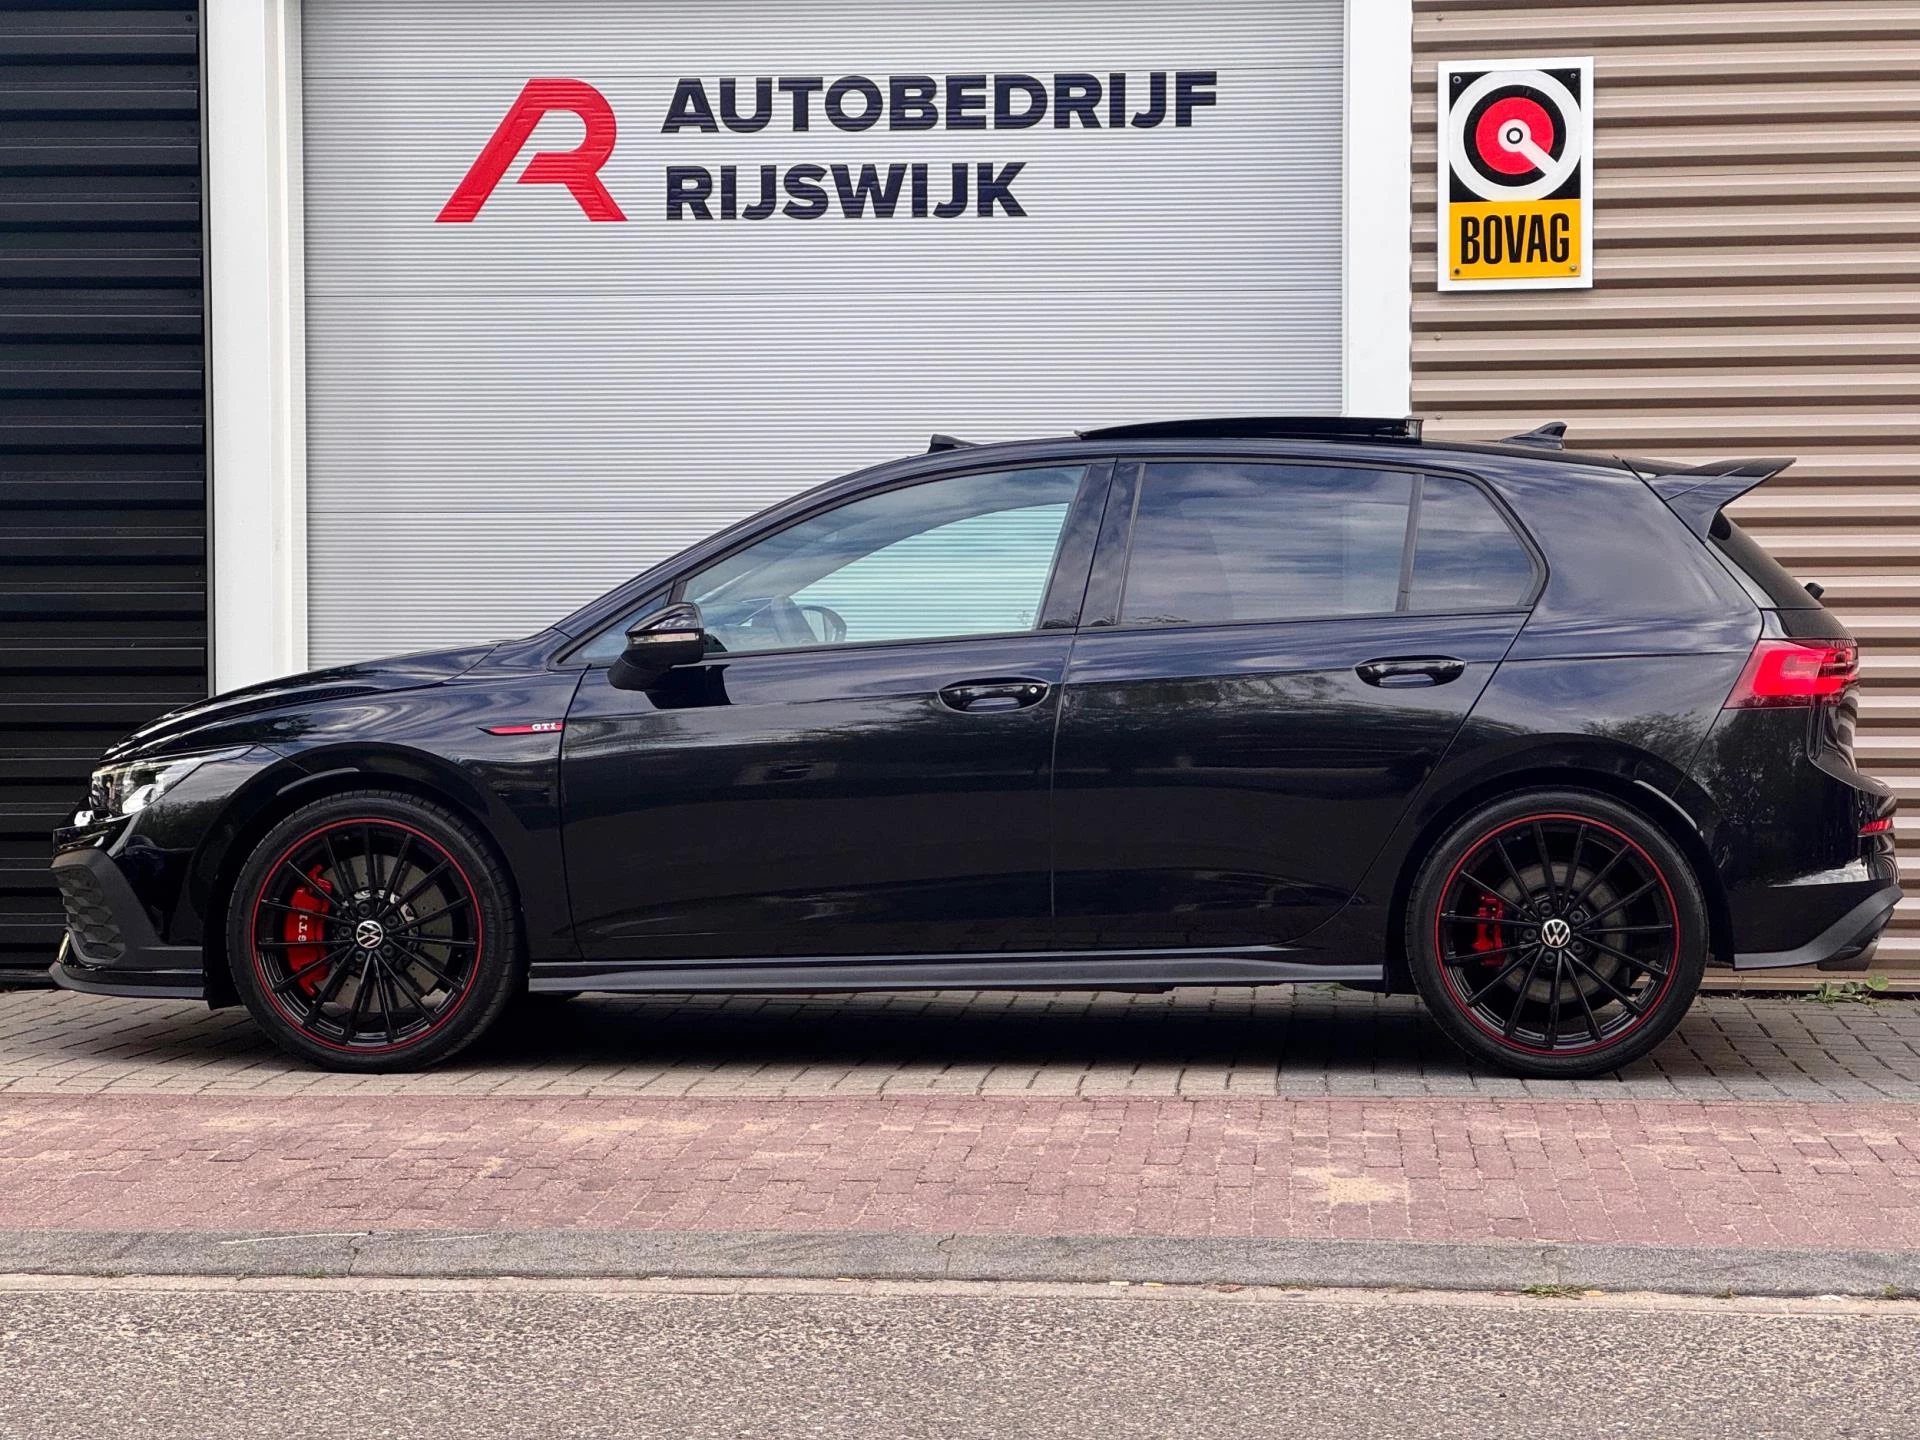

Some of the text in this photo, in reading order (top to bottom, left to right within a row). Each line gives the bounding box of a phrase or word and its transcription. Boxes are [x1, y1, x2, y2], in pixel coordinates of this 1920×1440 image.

[661, 71, 1217, 133] AUTOBEDRIJF
[666, 161, 1028, 221] RIJSWIJK
[1460, 212, 1570, 265] BOVAG
[531, 722, 557, 732] GTI
[297, 914, 308, 942] GTI
